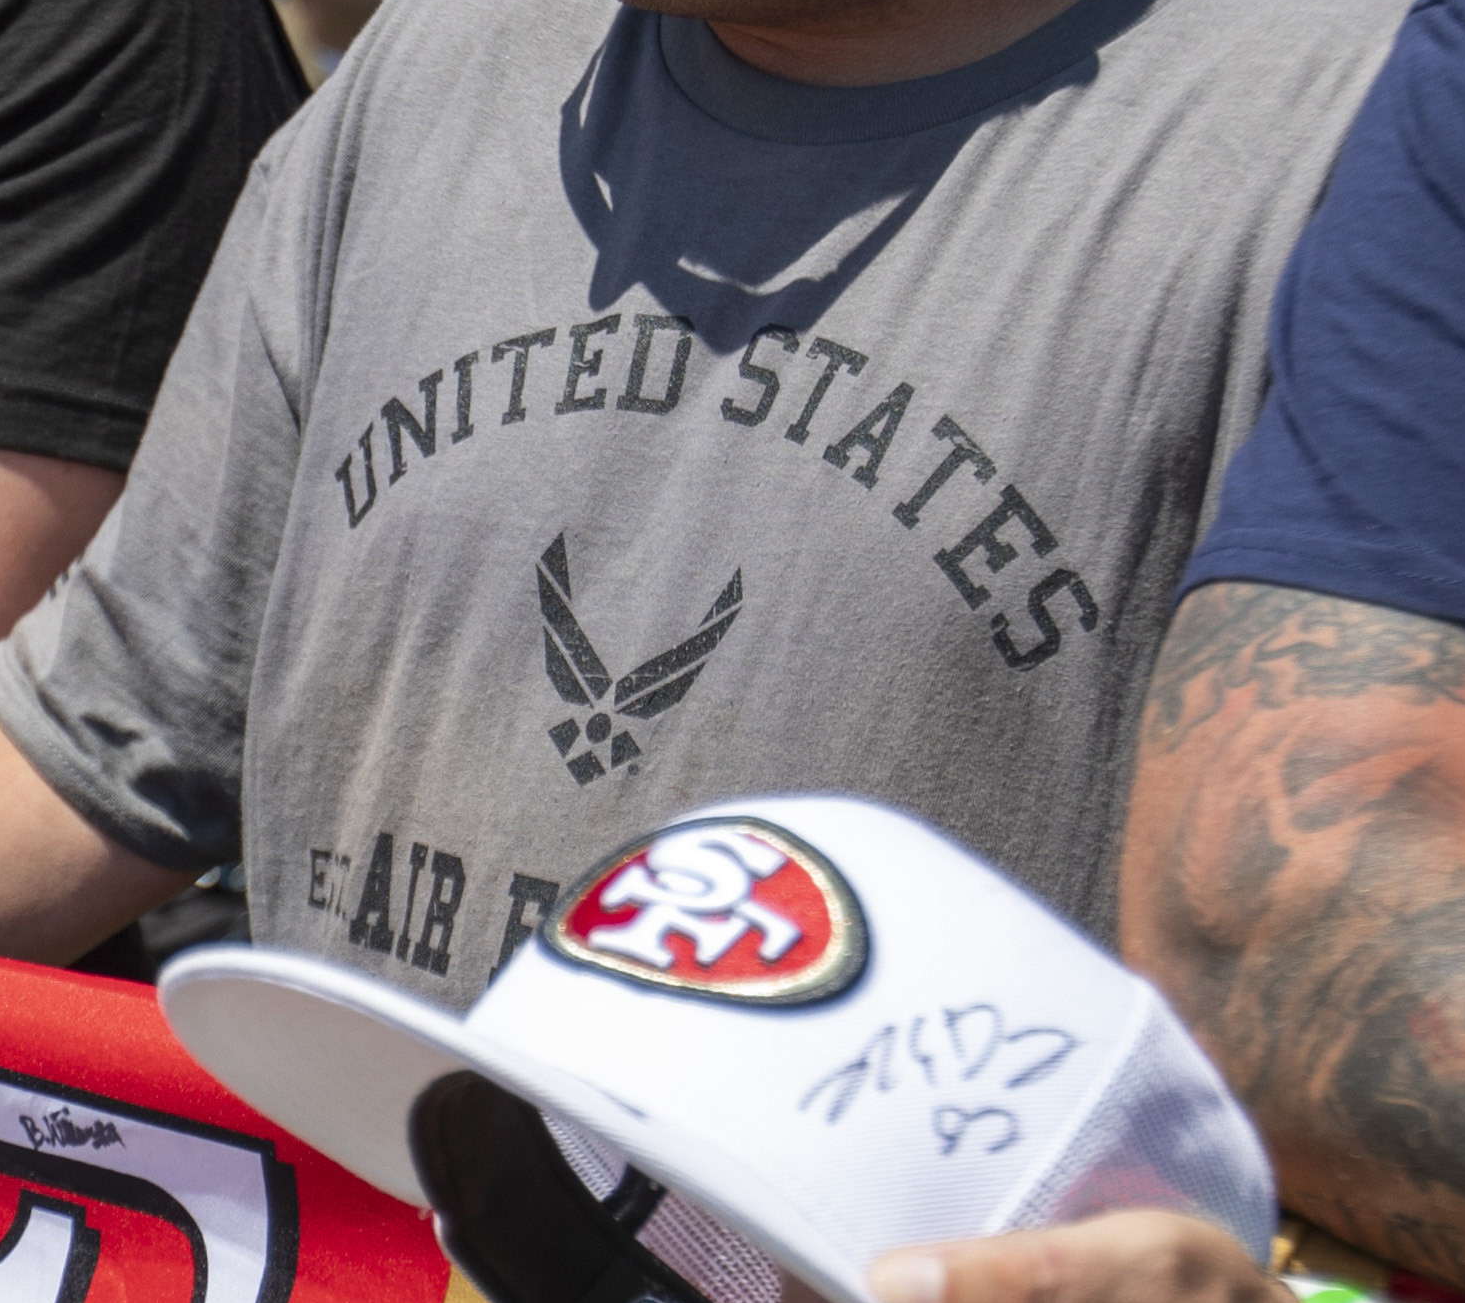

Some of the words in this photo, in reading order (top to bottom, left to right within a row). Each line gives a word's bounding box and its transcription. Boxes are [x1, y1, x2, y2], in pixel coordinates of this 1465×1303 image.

[334, 311, 695, 530] UNITED
[719, 323, 1102, 674] STATES
[348, 831, 467, 978] AIR
[587, 826, 804, 971] SF
